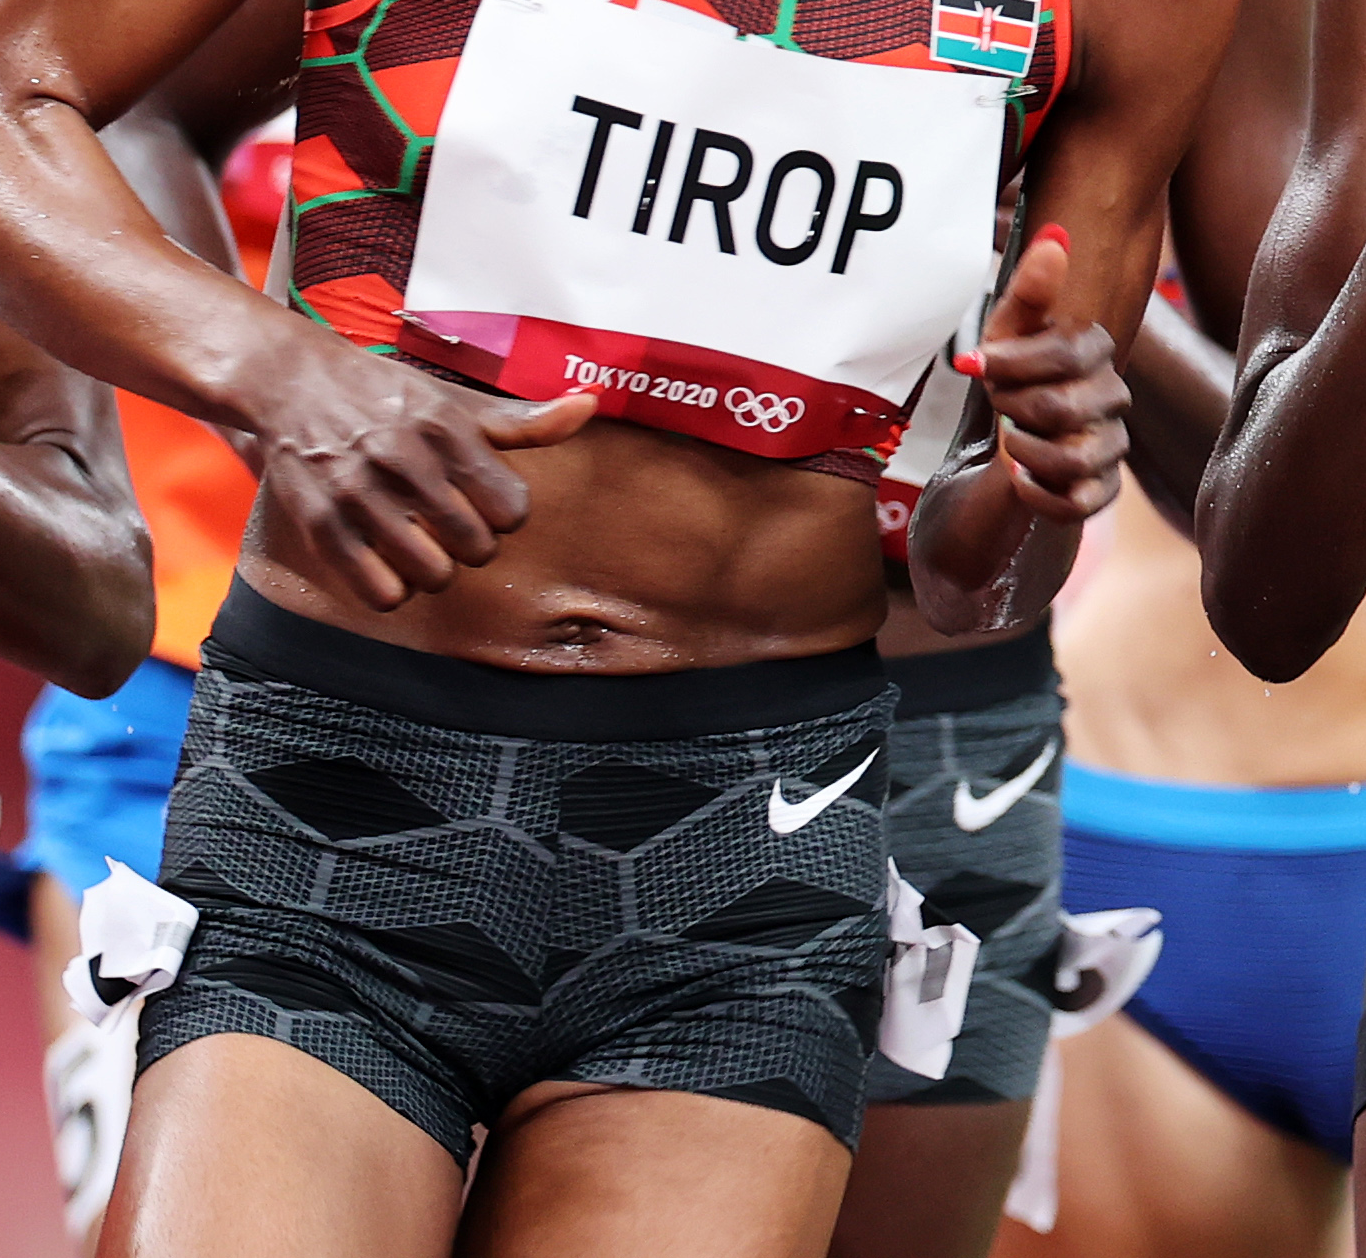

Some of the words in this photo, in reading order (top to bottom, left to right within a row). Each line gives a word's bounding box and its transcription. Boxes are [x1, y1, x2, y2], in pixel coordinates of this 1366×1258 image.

[572, 95, 904, 275] TIROP
[564, 354, 650, 393] TOKYO
[649, 377, 718, 409] 2020
